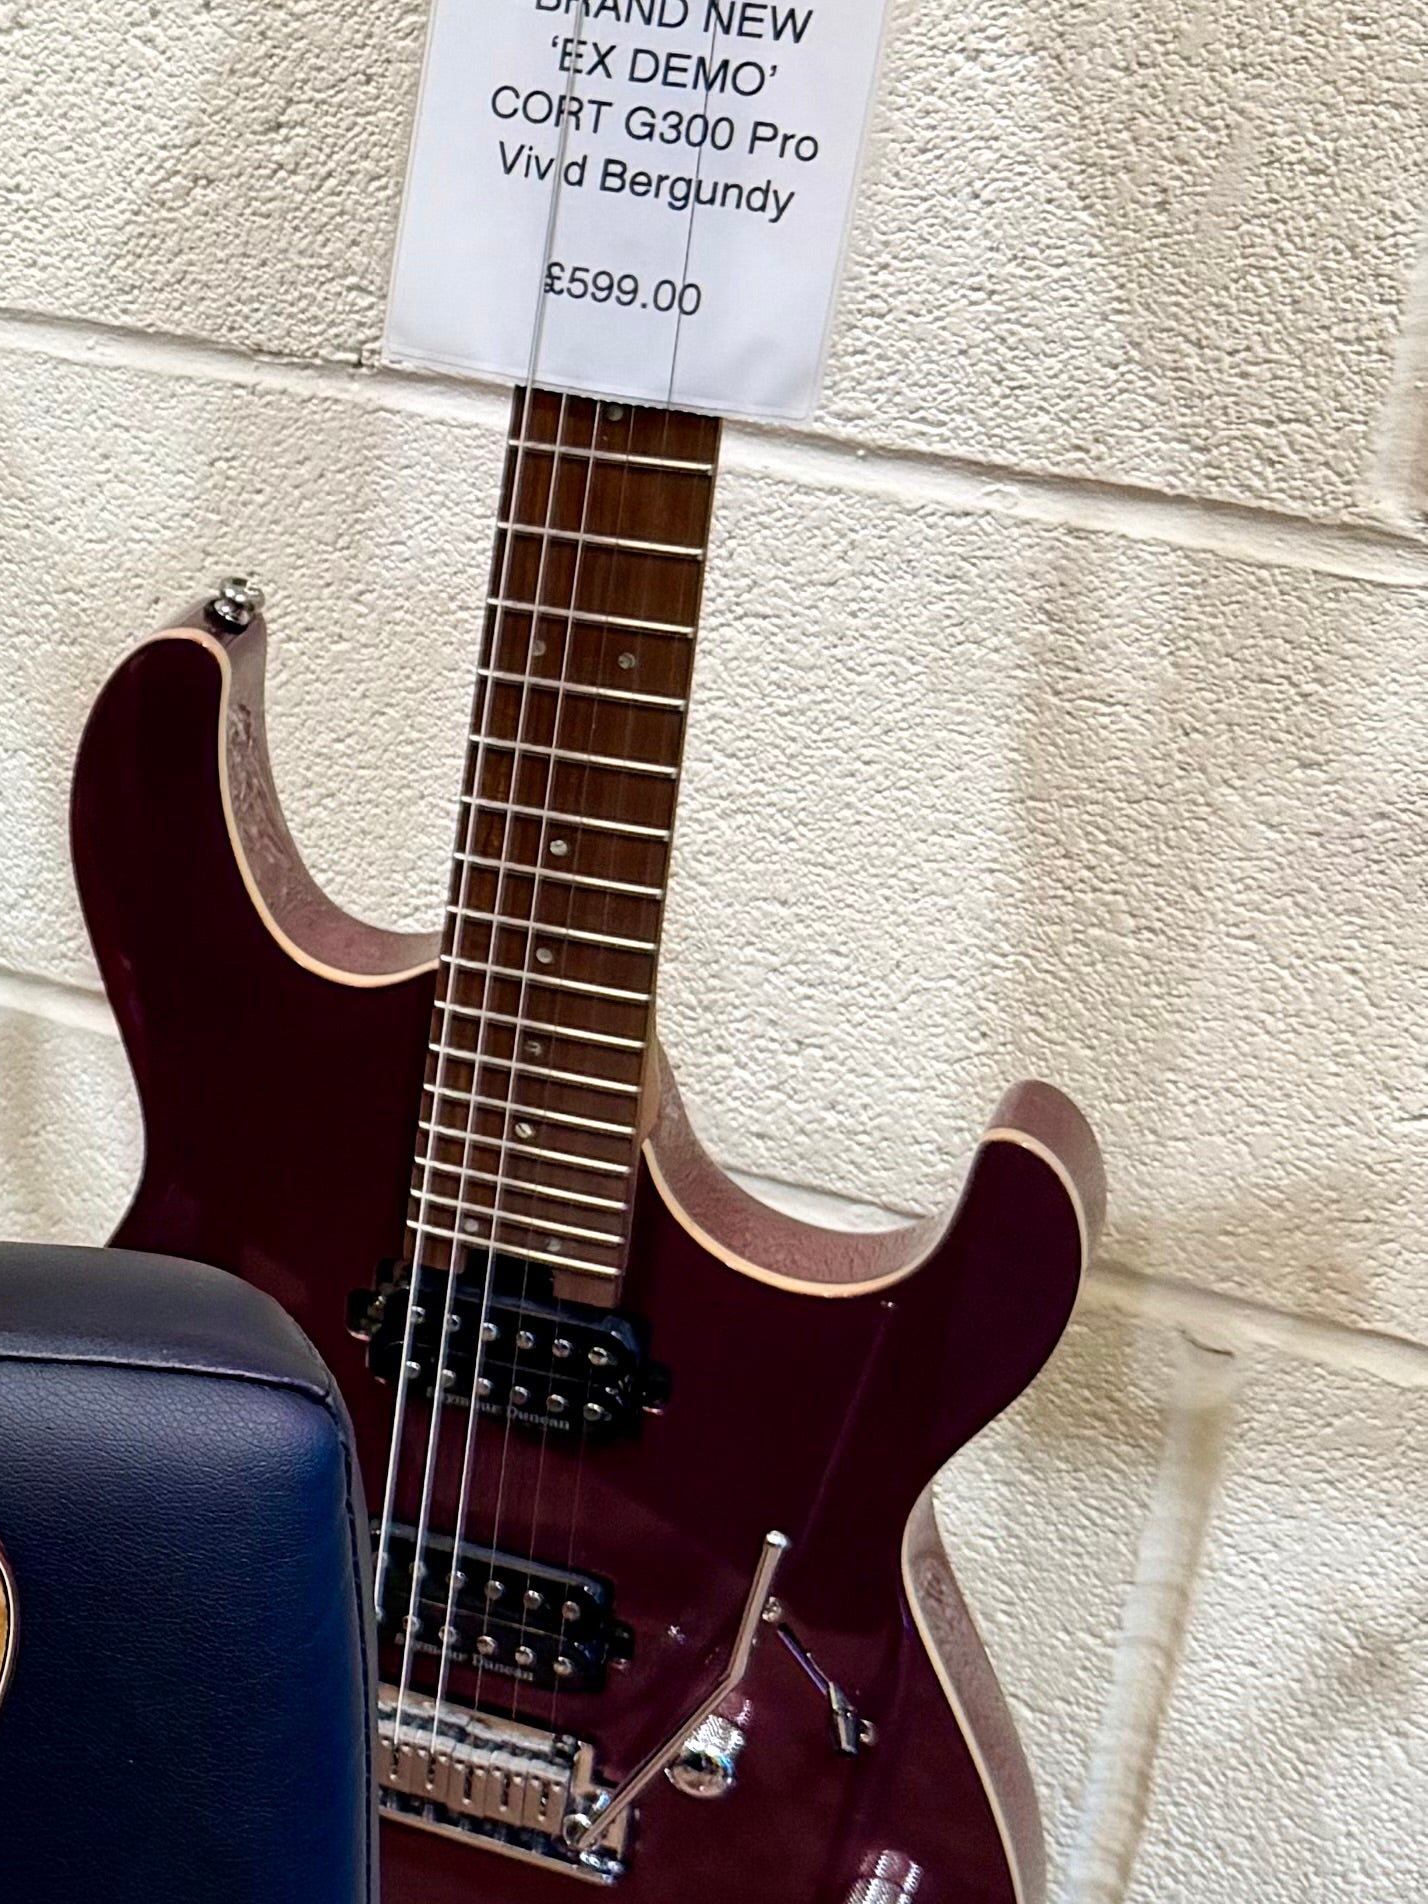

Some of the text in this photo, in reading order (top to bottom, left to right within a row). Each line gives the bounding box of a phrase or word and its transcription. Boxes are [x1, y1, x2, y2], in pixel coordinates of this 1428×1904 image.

[704, 1, 813, 44] NEW
[490, 85, 819, 163] CORT G300 Pro
[499, 140, 795, 223] Vivd Bergundy
[543, 260, 702, 317] £599.00
